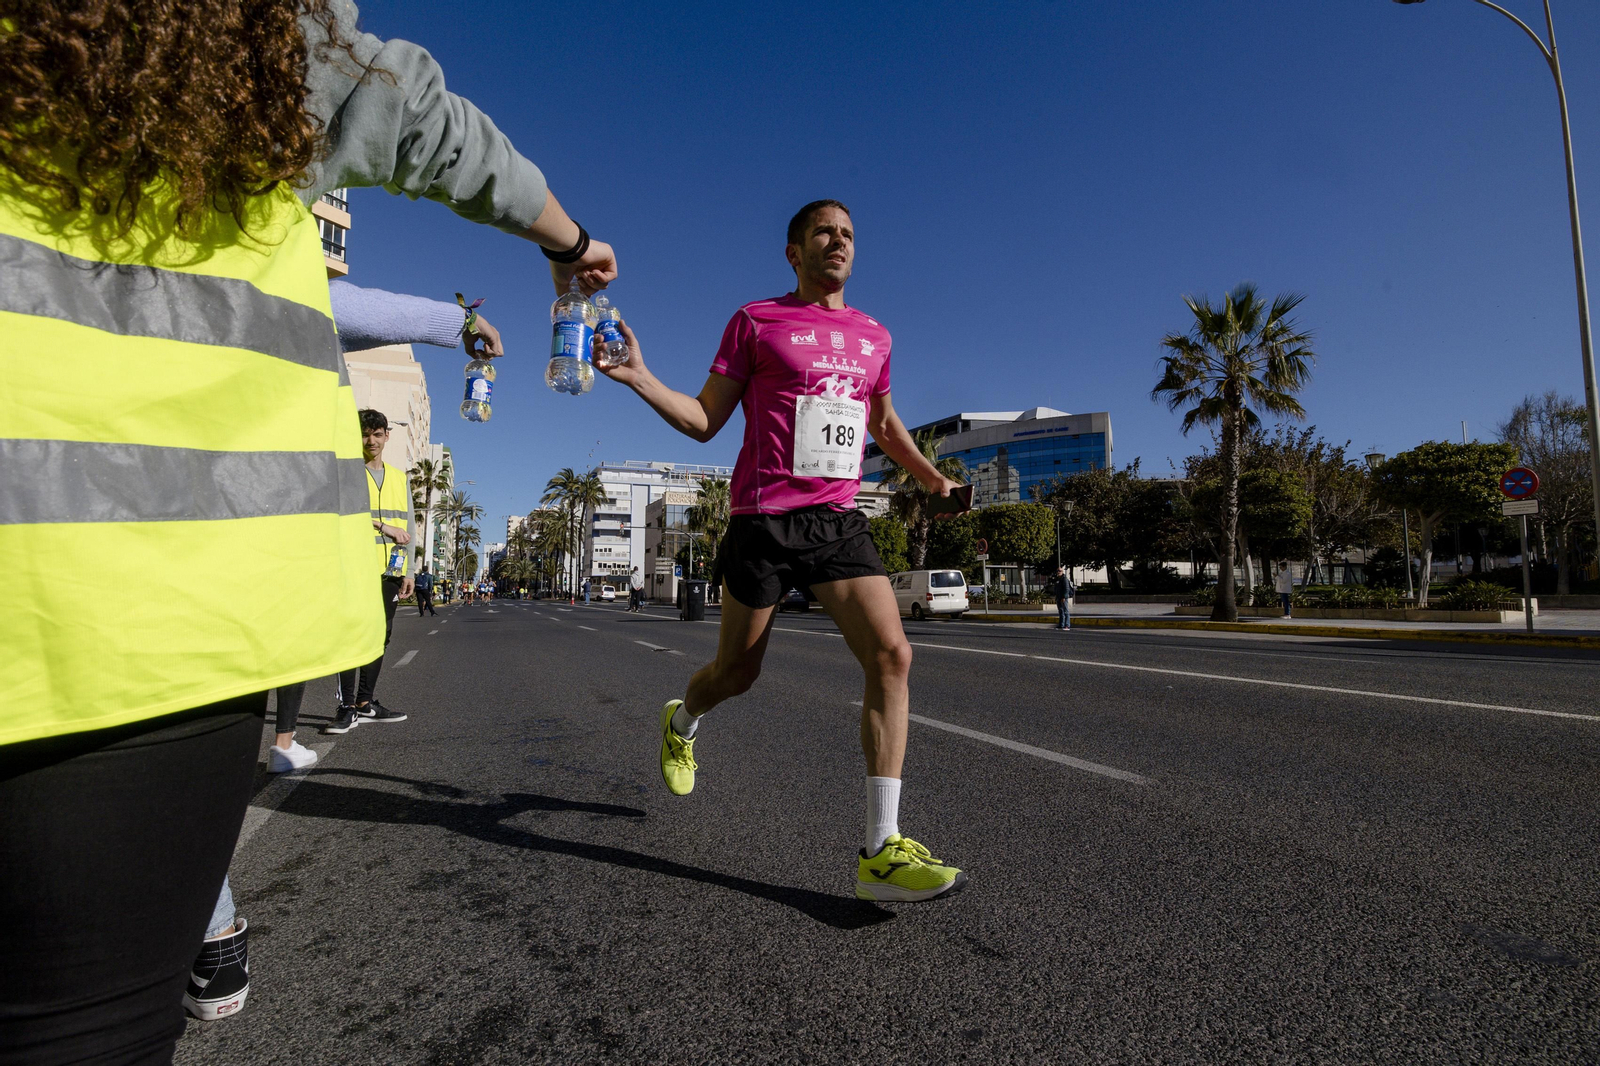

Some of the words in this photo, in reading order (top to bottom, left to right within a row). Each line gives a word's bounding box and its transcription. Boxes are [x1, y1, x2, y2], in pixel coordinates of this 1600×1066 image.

[812, 361, 835, 370] MEDIA
[834, 364, 866, 375] MARATÓN
[821, 423, 855, 447] 189
